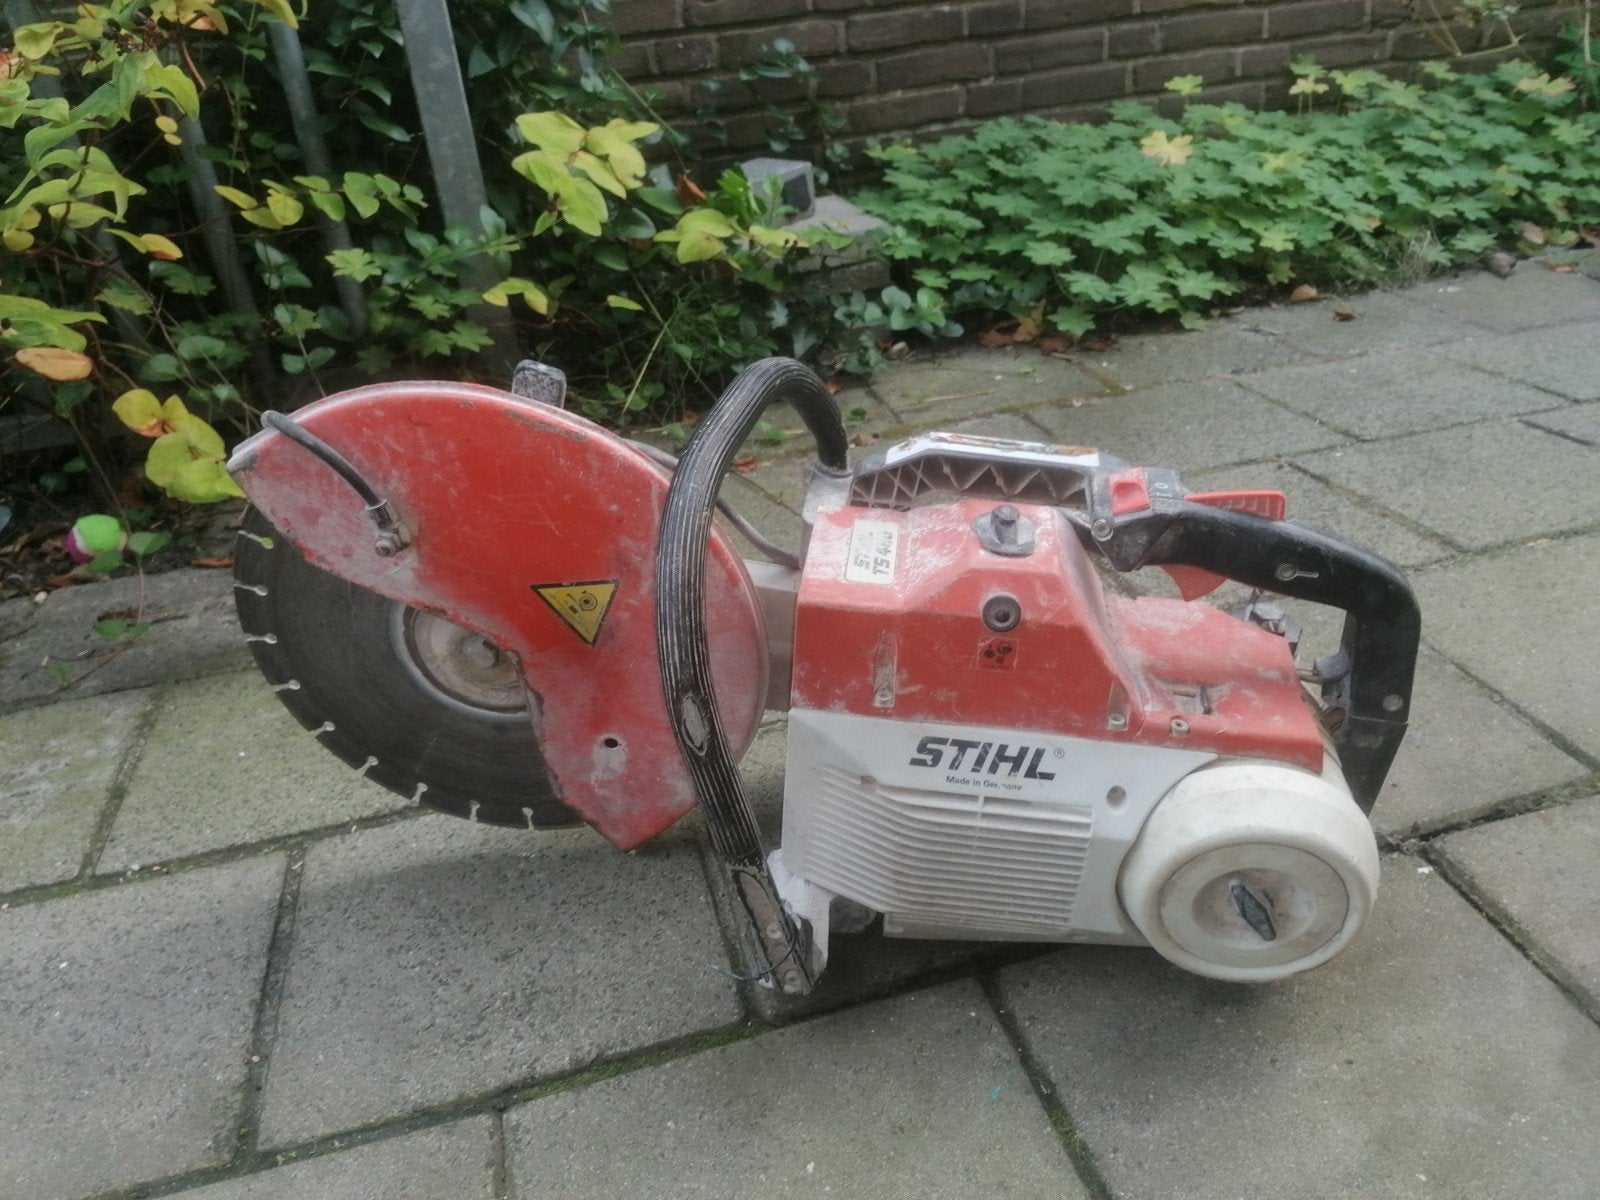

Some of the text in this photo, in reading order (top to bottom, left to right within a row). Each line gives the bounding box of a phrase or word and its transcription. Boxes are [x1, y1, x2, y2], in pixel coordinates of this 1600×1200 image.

[872, 556, 890, 575] TS
[909, 736, 1057, 781] STIHL
[946, 774, 970, 786] Made
[972, 776, 981, 787] in
